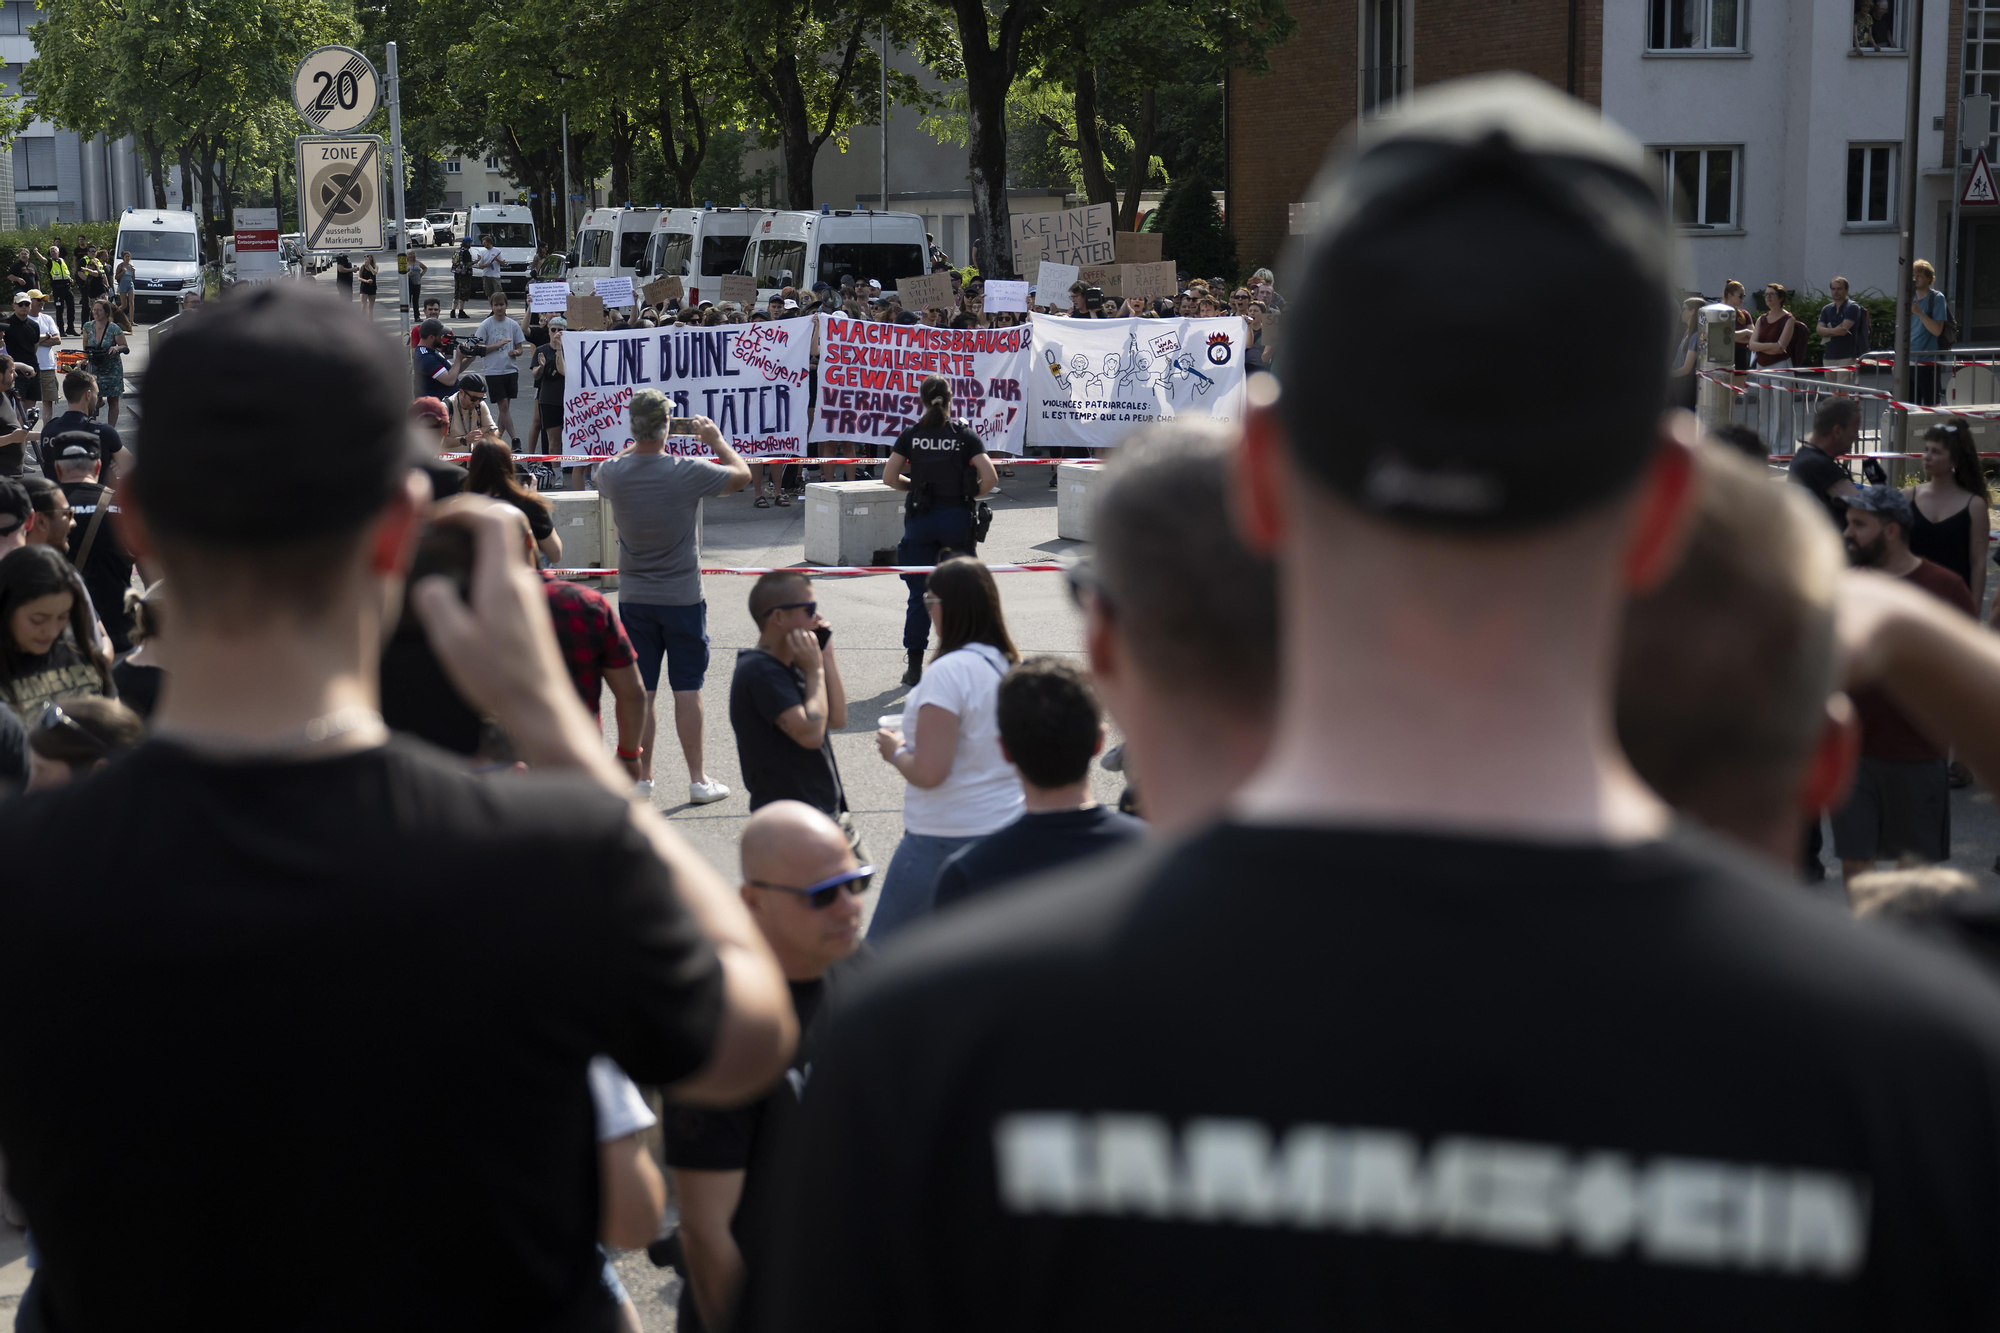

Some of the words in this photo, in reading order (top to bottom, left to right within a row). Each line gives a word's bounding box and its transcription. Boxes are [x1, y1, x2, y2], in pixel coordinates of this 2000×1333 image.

[313, 70, 358, 110] 20
[322, 147, 358, 160] ZONE
[1022, 207, 1102, 234] KEINE
[325, 226, 362, 236] ausserhalb
[1022, 225, 1099, 250] ÜHNE
[325, 236, 363, 246] Markierung
[1056, 242, 1112, 266] TÄTER
[1043, 267, 1069, 279] STOP
[1083, 270, 1106, 280] OPFER
[1135, 265, 1161, 276] STOP
[910, 277, 934, 289] STOP
[1041, 278, 1068, 289] VICTIM
[1136, 275, 1167, 286] RAPE-
[1133, 286, 1167, 296] CULTURE
[749, 323, 790, 348] Kein
[827, 318, 1019, 353] MACHTMISSBRAUCH
[1020, 328, 1032, 350] &
[1156, 344, 1179, 355] MENOS
[1158, 339, 1173, 349] UNA
[580, 336, 652, 388] KEINE
[660, 331, 740, 382] BÜHNE
[825, 344, 974, 377] SEXUALISIERTE
[732, 347, 809, 388] schweigen!
[989, 378, 1022, 401] IHR
[821, 386, 986, 418] VERANSTLTET
[1042, 400, 1082, 409] VIOLENCES
[1085, 400, 1151, 410] PATRIARCALES:
[702, 385, 790, 436] TÄTER
[1052, 411, 1067, 420] EST
[1069, 412, 1097, 420] TEMPS
[1100, 413, 1116, 421] QUE
[1133, 414, 1154, 423] PEUR
[1156, 414, 1188, 423] CHAN
[820, 407, 972, 437] TROTZD
[912, 438, 960, 451] POLICE
